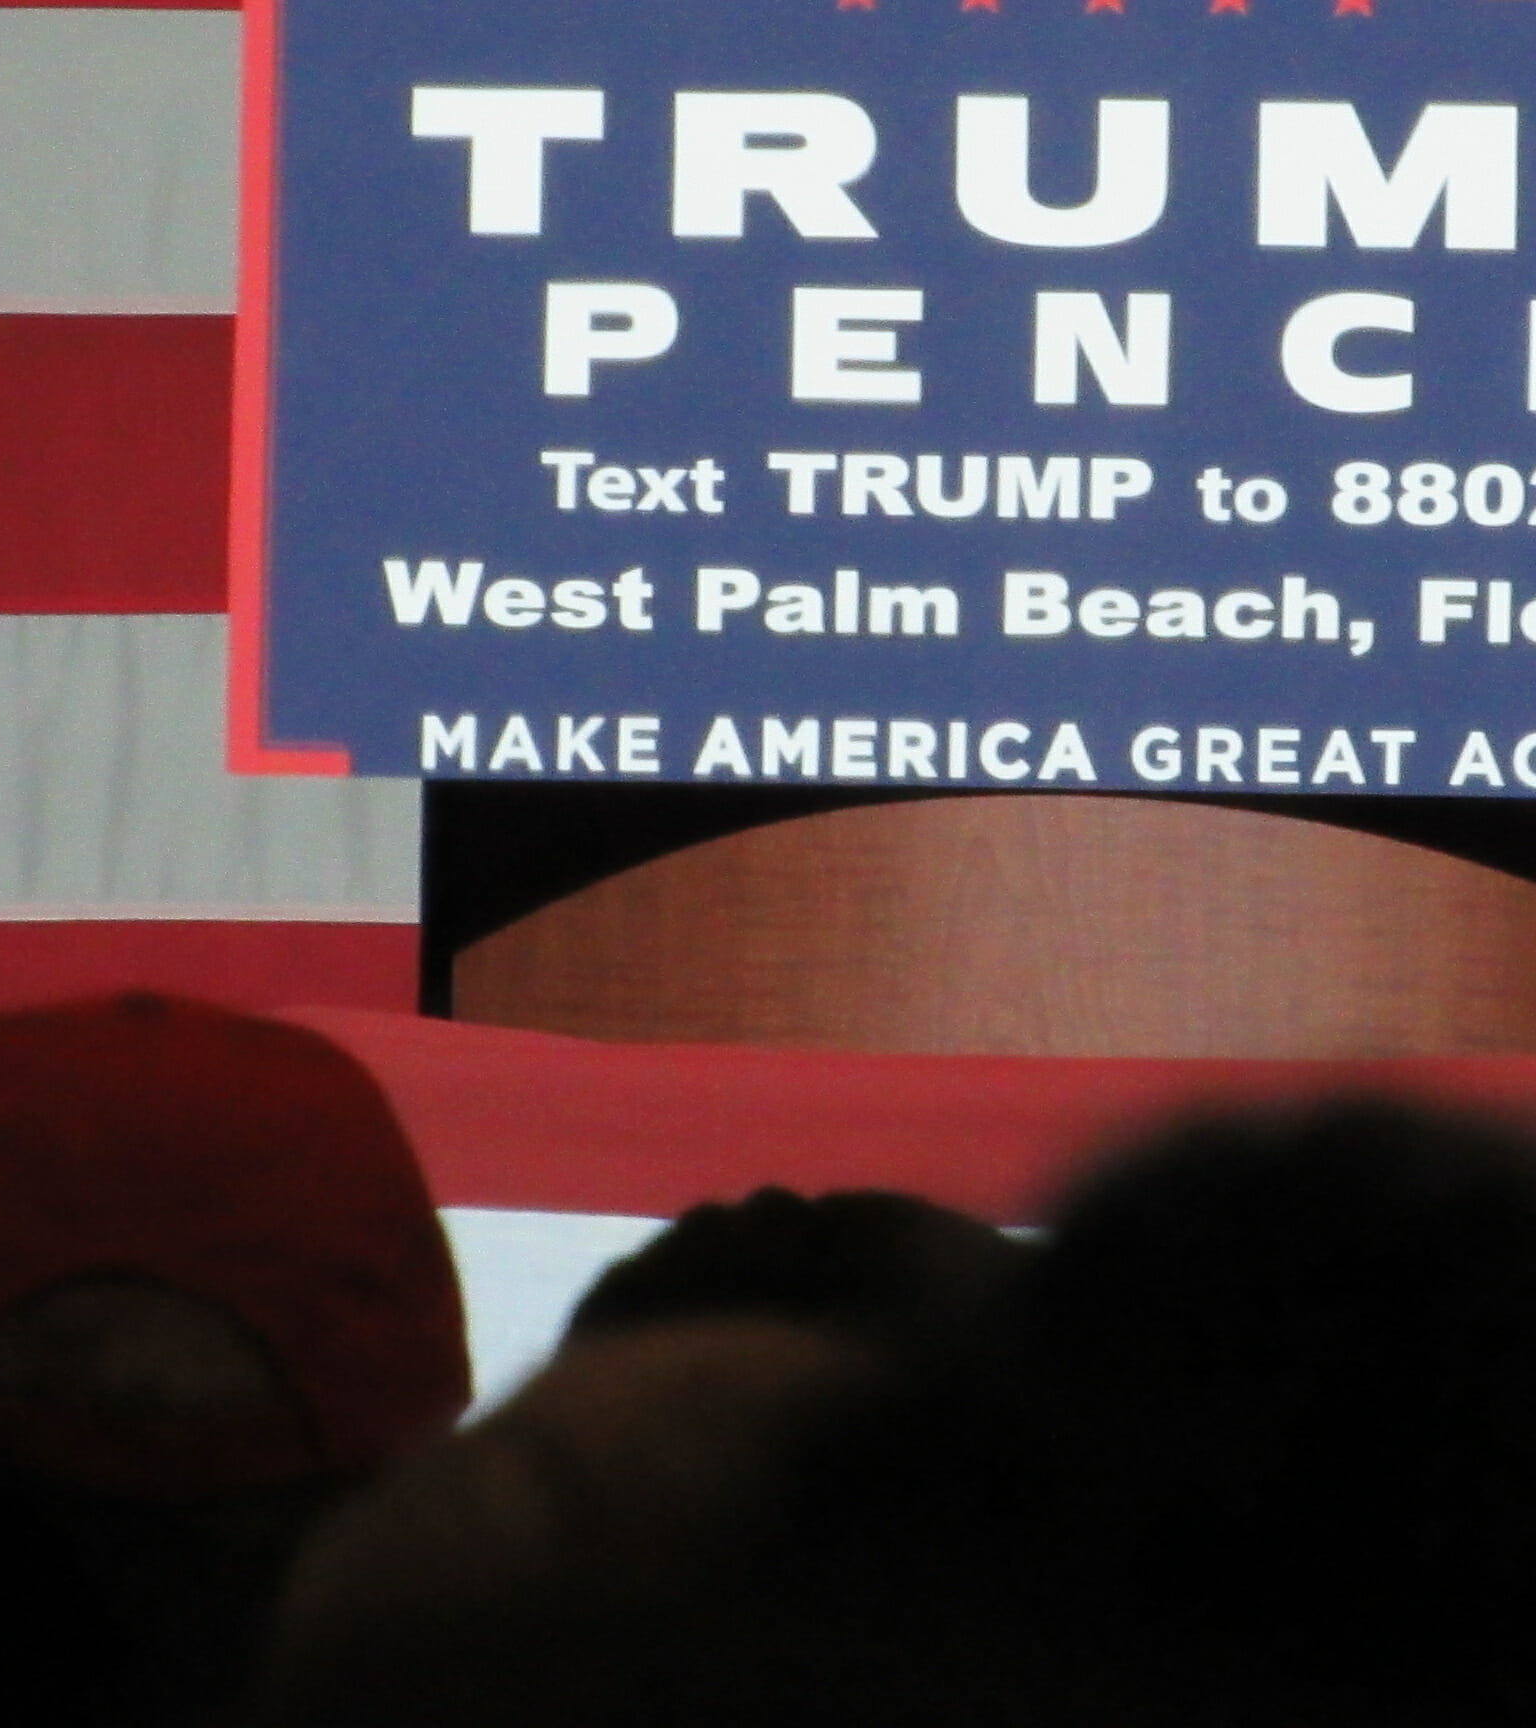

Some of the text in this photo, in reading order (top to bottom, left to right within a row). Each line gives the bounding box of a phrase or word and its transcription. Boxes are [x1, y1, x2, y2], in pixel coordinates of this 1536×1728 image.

[540, 449, 726, 515] Text
[766, 451, 1155, 522] TRUMP
[1195, 466, 1289, 525] to
[382, 556, 655, 631] West
[694, 565, 960, 637] Palm
[1002, 570, 1375, 657] Beach,
[420, 712, 661, 774] MAKE
[693, 715, 1098, 782] AMERICA
[1129, 724, 1417, 786] GREAT
